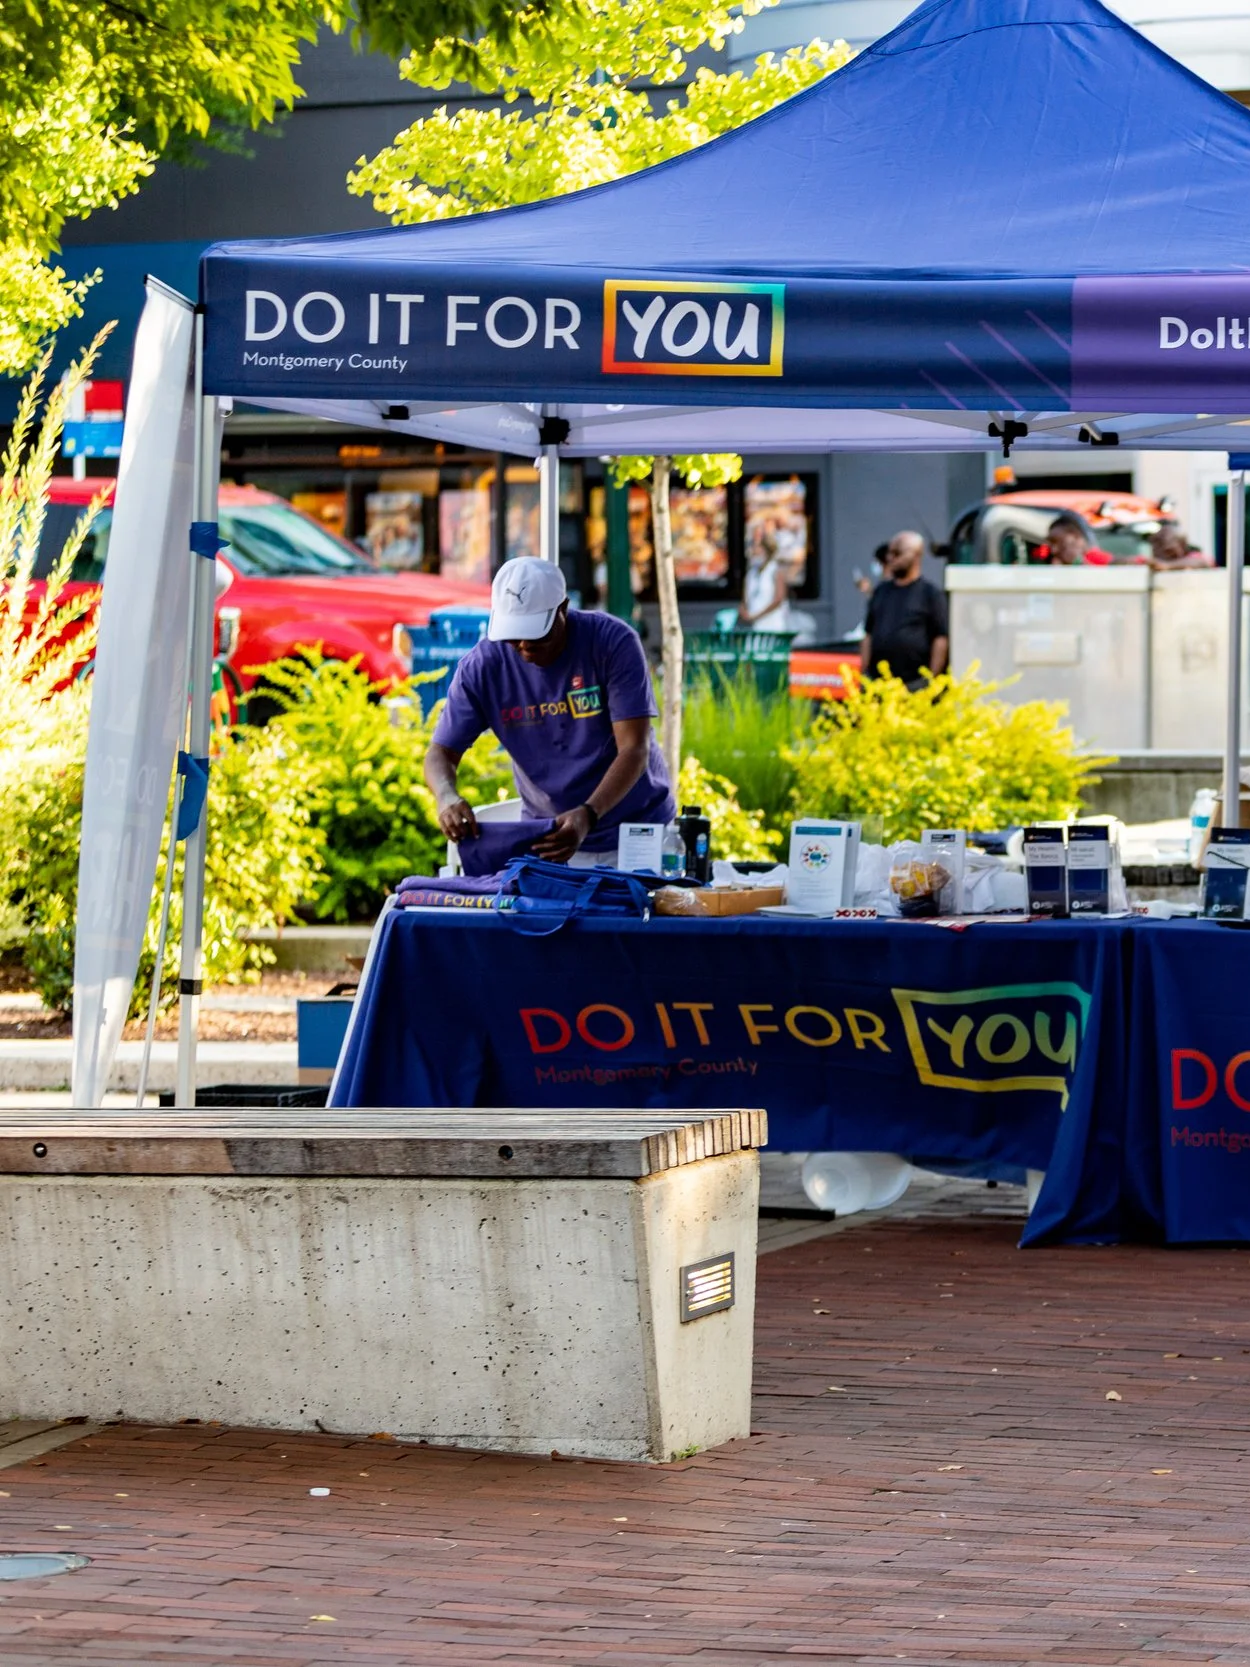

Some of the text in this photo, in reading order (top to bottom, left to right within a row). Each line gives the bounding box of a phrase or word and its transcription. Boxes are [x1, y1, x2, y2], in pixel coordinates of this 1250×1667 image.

[245, 290, 581, 350] DO IT FOR
[622, 295, 760, 360] YOU
[243, 352, 408, 373] Montgomery County
[525, 704, 537, 720] IT
[540, 700, 567, 718] FOR
[573, 691, 601, 711] YOU
[427, 893, 442, 905] IT
[444, 894, 475, 907] FOR
[519, 1002, 892, 1054] DO IT FOR
[926, 1010, 1078, 1073] YOU
[534, 1057, 758, 1086] Montgomery County
